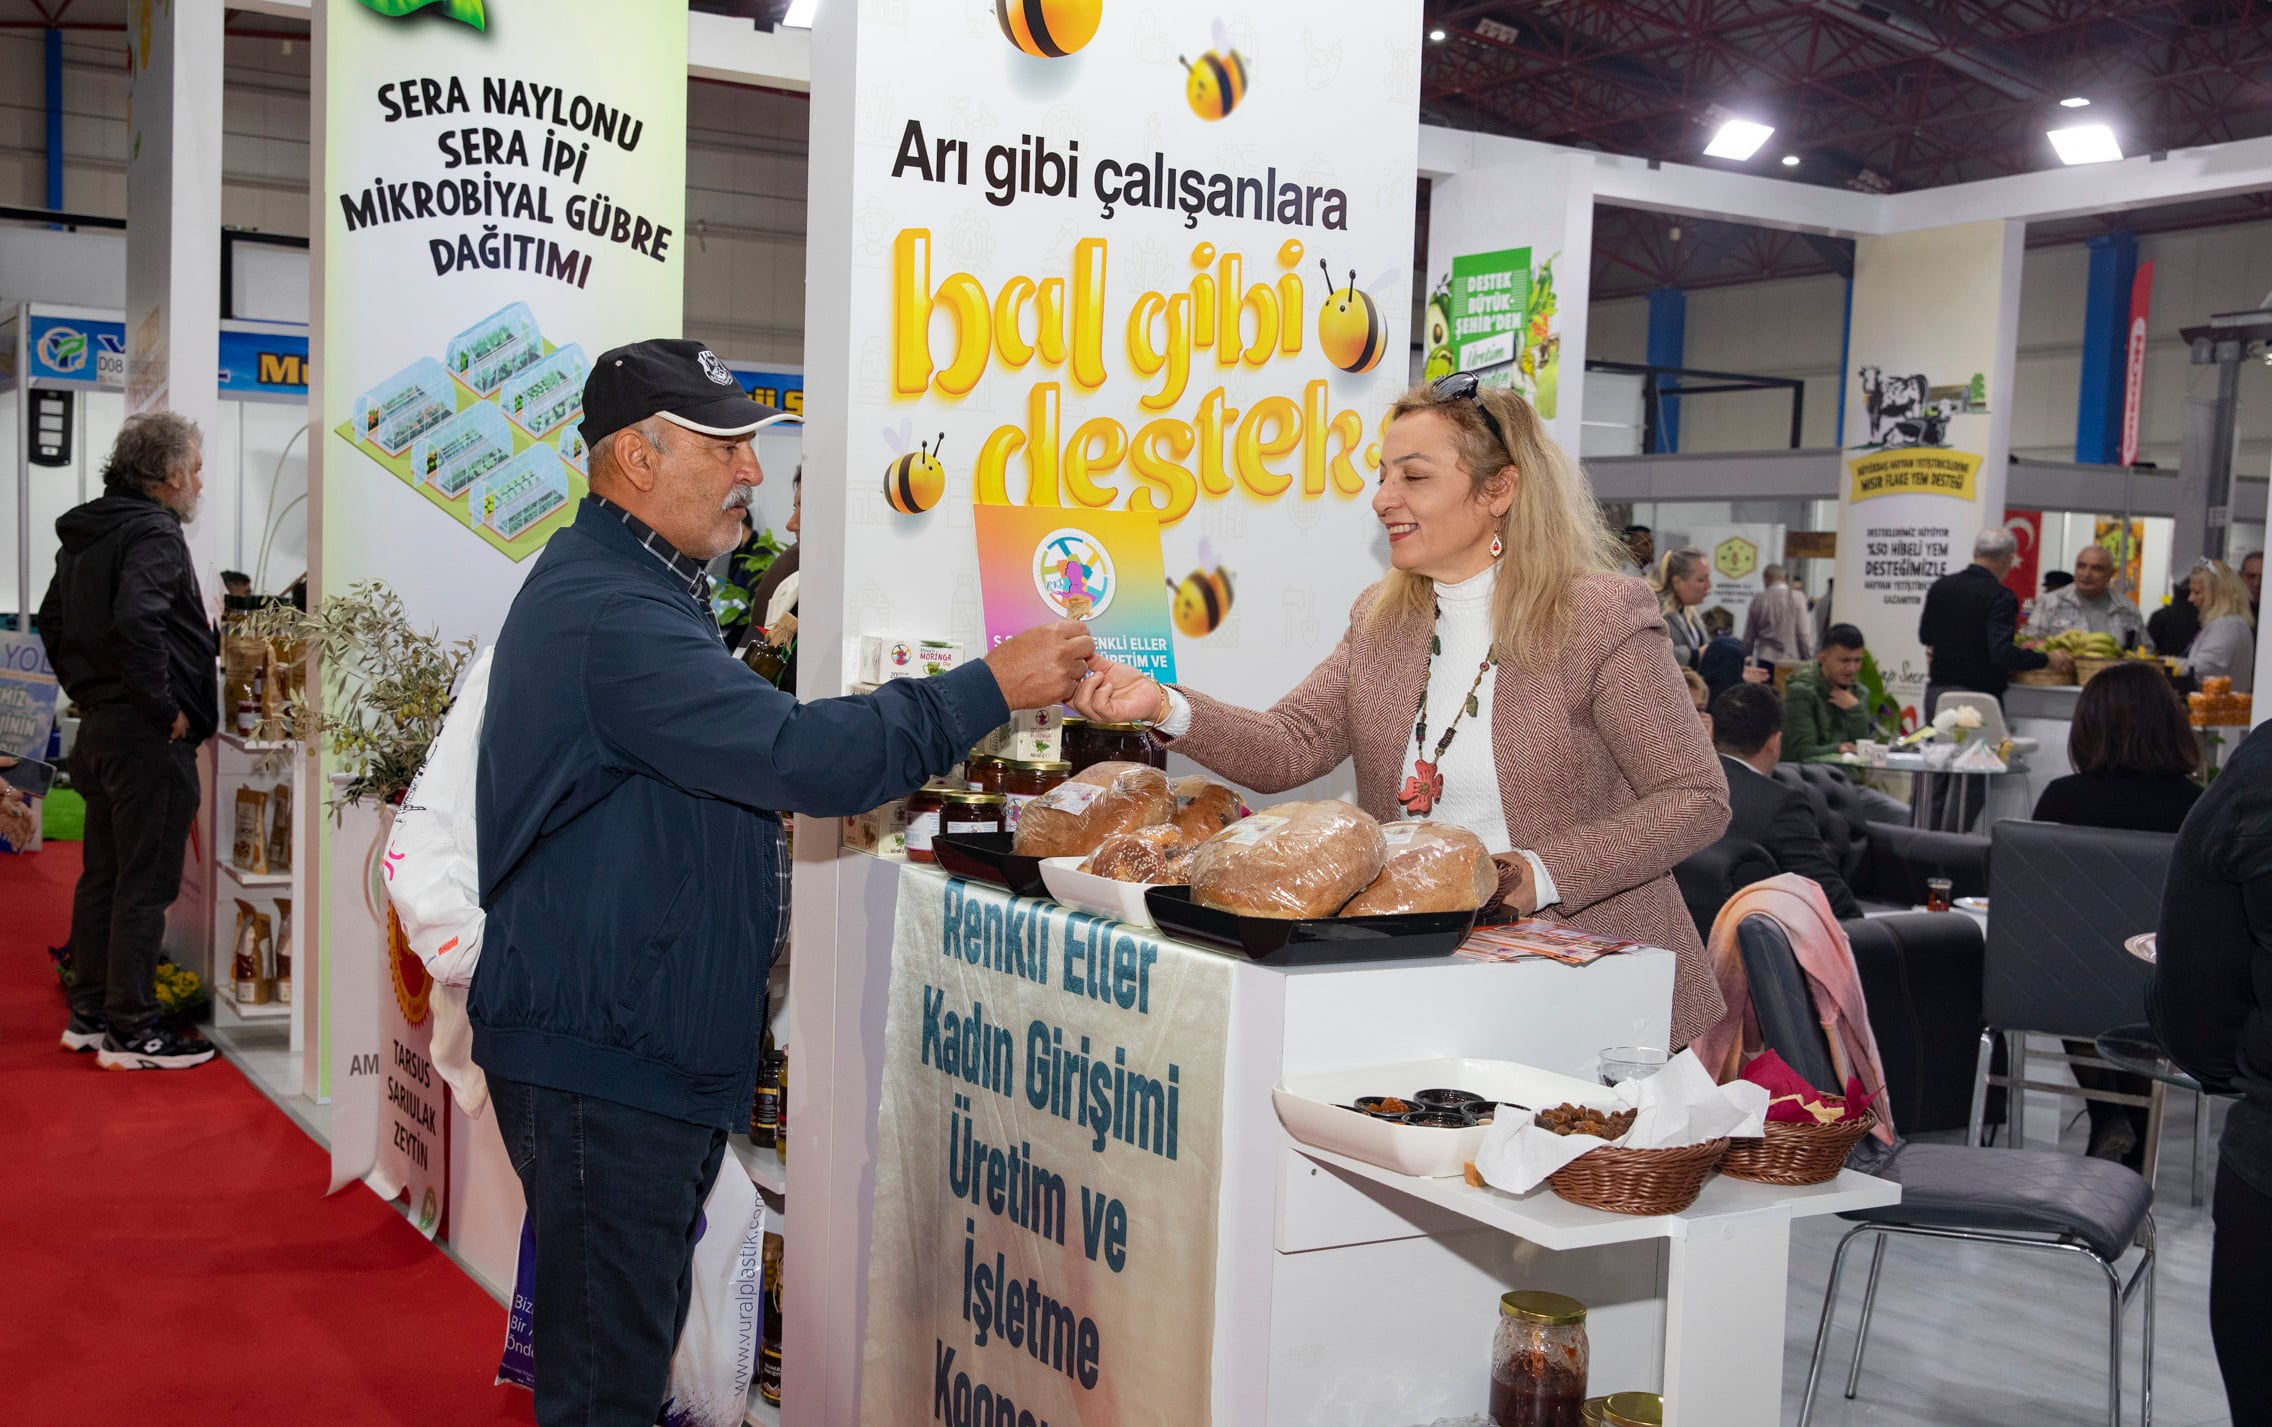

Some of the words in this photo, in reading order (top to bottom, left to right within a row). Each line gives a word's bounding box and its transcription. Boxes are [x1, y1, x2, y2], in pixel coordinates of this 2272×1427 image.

[377, 75, 469, 123] SERA
[481, 76, 643, 152] NAYLONU
[438, 128, 529, 169] SERA
[541, 128, 591, 185] İPİ
[891, 119, 968, 186] Arı
[984, 133, 1079, 208] gibi
[1094, 151, 1349, 232] çalışanlara
[340, 170, 554, 232] MİKROBİYAL
[565, 193, 673, 264] GÜBRE
[429, 224, 594, 289] DAĞITIMI
[1467, 272, 1512, 292] DESTEK
[893, 227, 1109, 397] bal
[1127, 237, 1305, 411] gibi
[1926, 543, 1949, 556] YEM
[1092, 635, 1127, 650] ENKLİ
[1130, 637, 1167, 651] ELLER
[1151, 655, 1168, 667] VE
[944, 878, 1050, 985] Renkli
[1063, 911, 1158, 1015] Eller
[393, 1039, 430, 1088] TARSUS
[922, 984, 1013, 1098] Kadın
[1026, 1019, 1179, 1161] Girişimi
[388, 1076, 436, 1136] SARIULAK
[394, 1120, 428, 1171] ZEYTİN
[949, 1093, 1066, 1247] Üretim
[1081, 1186, 1127, 1273] ve
[510, 1315, 527, 1333] Bir
[962, 1217, 1100, 1390] İşletme
